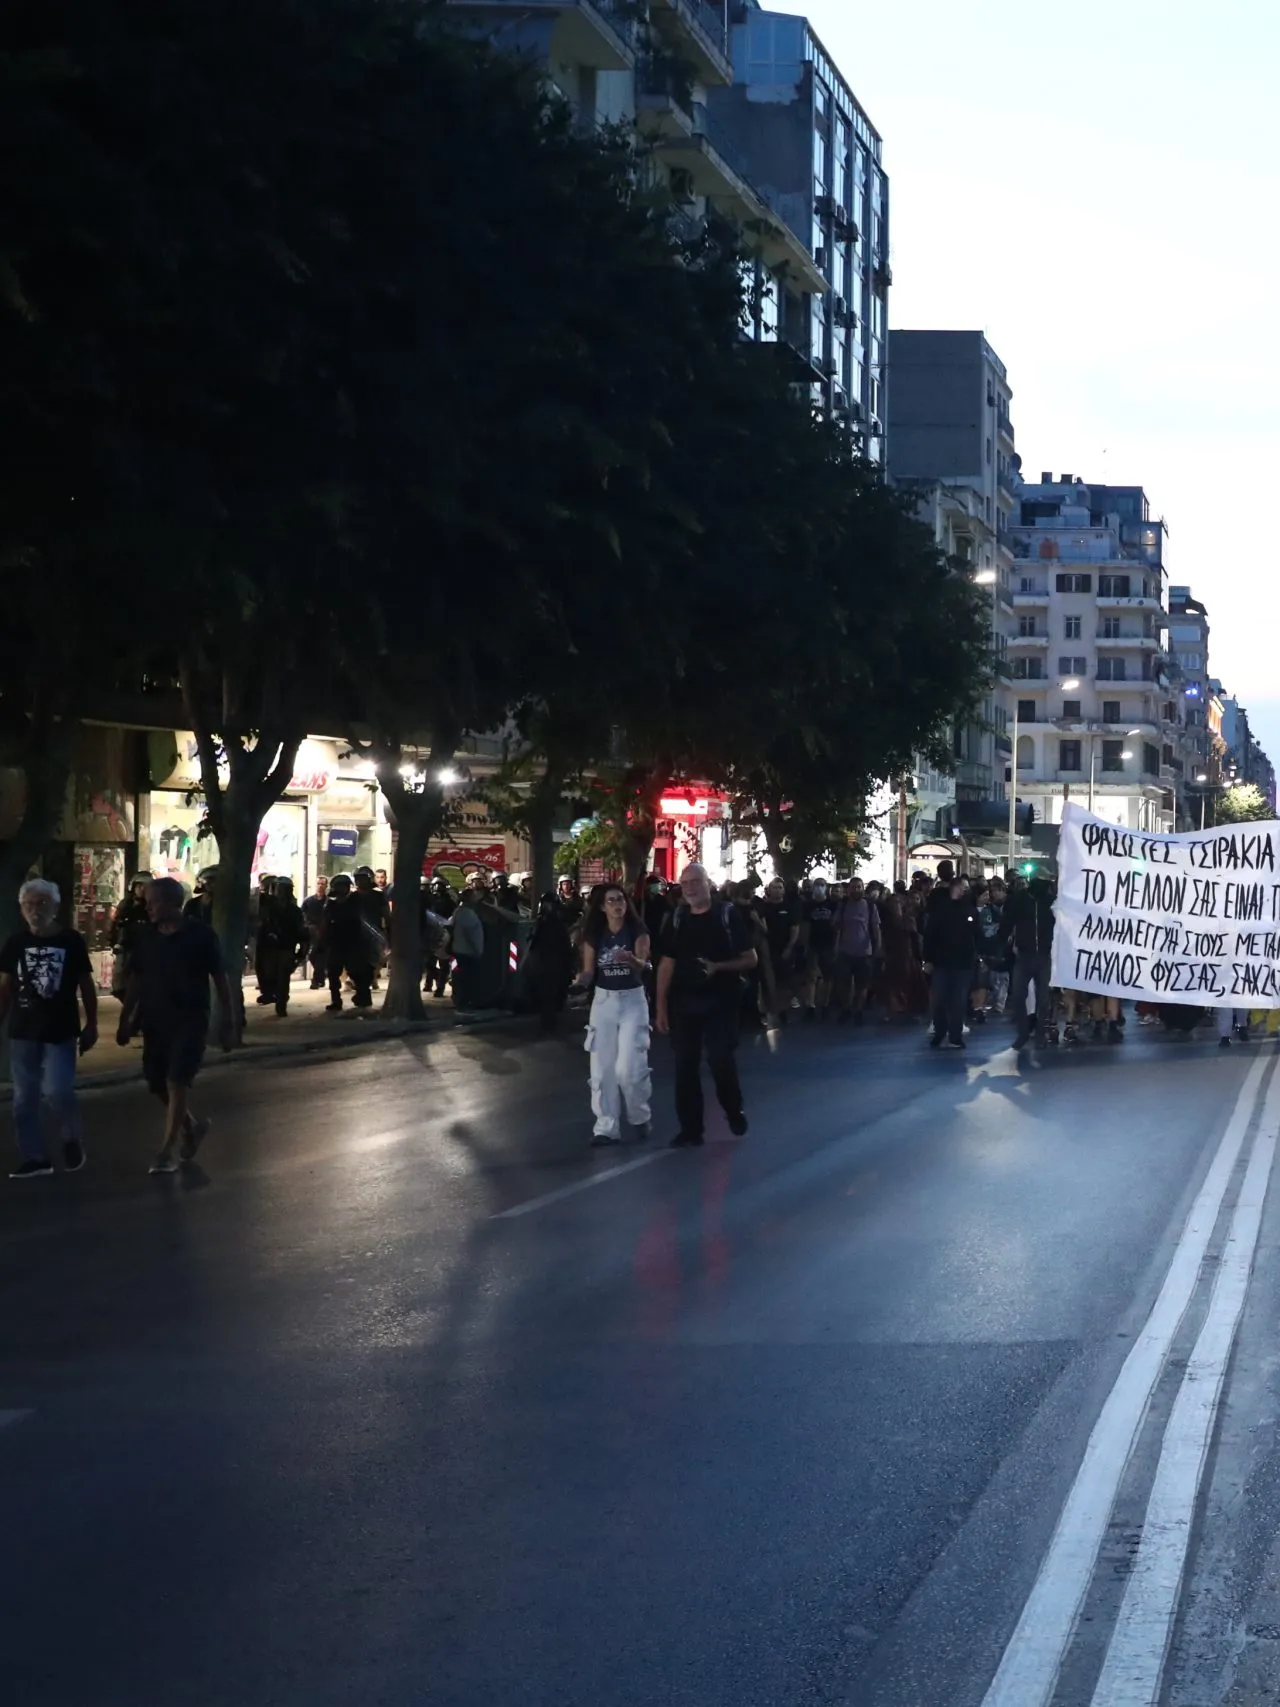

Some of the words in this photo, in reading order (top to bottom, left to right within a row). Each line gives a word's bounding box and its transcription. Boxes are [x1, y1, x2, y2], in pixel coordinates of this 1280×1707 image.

[1188, 832, 1275, 873] ΤΣΙΡΑΚΙΑ
[1081, 868, 1106, 904] ΤΟ
[1114, 870, 1187, 914] ΜΕΛΛΟΝ
[1188, 878, 1220, 918] ΣΑΣ
[1224, 881, 1264, 920] ΕΙΝΑΙ
[1078, 913, 1179, 955] ΑΛΛΗΛΕΓΓΥΗ
[1182, 930, 1229, 957] ΣΤΟΥΣ
[1075, 949, 1148, 989] ΠΑΥΛΟΣ
